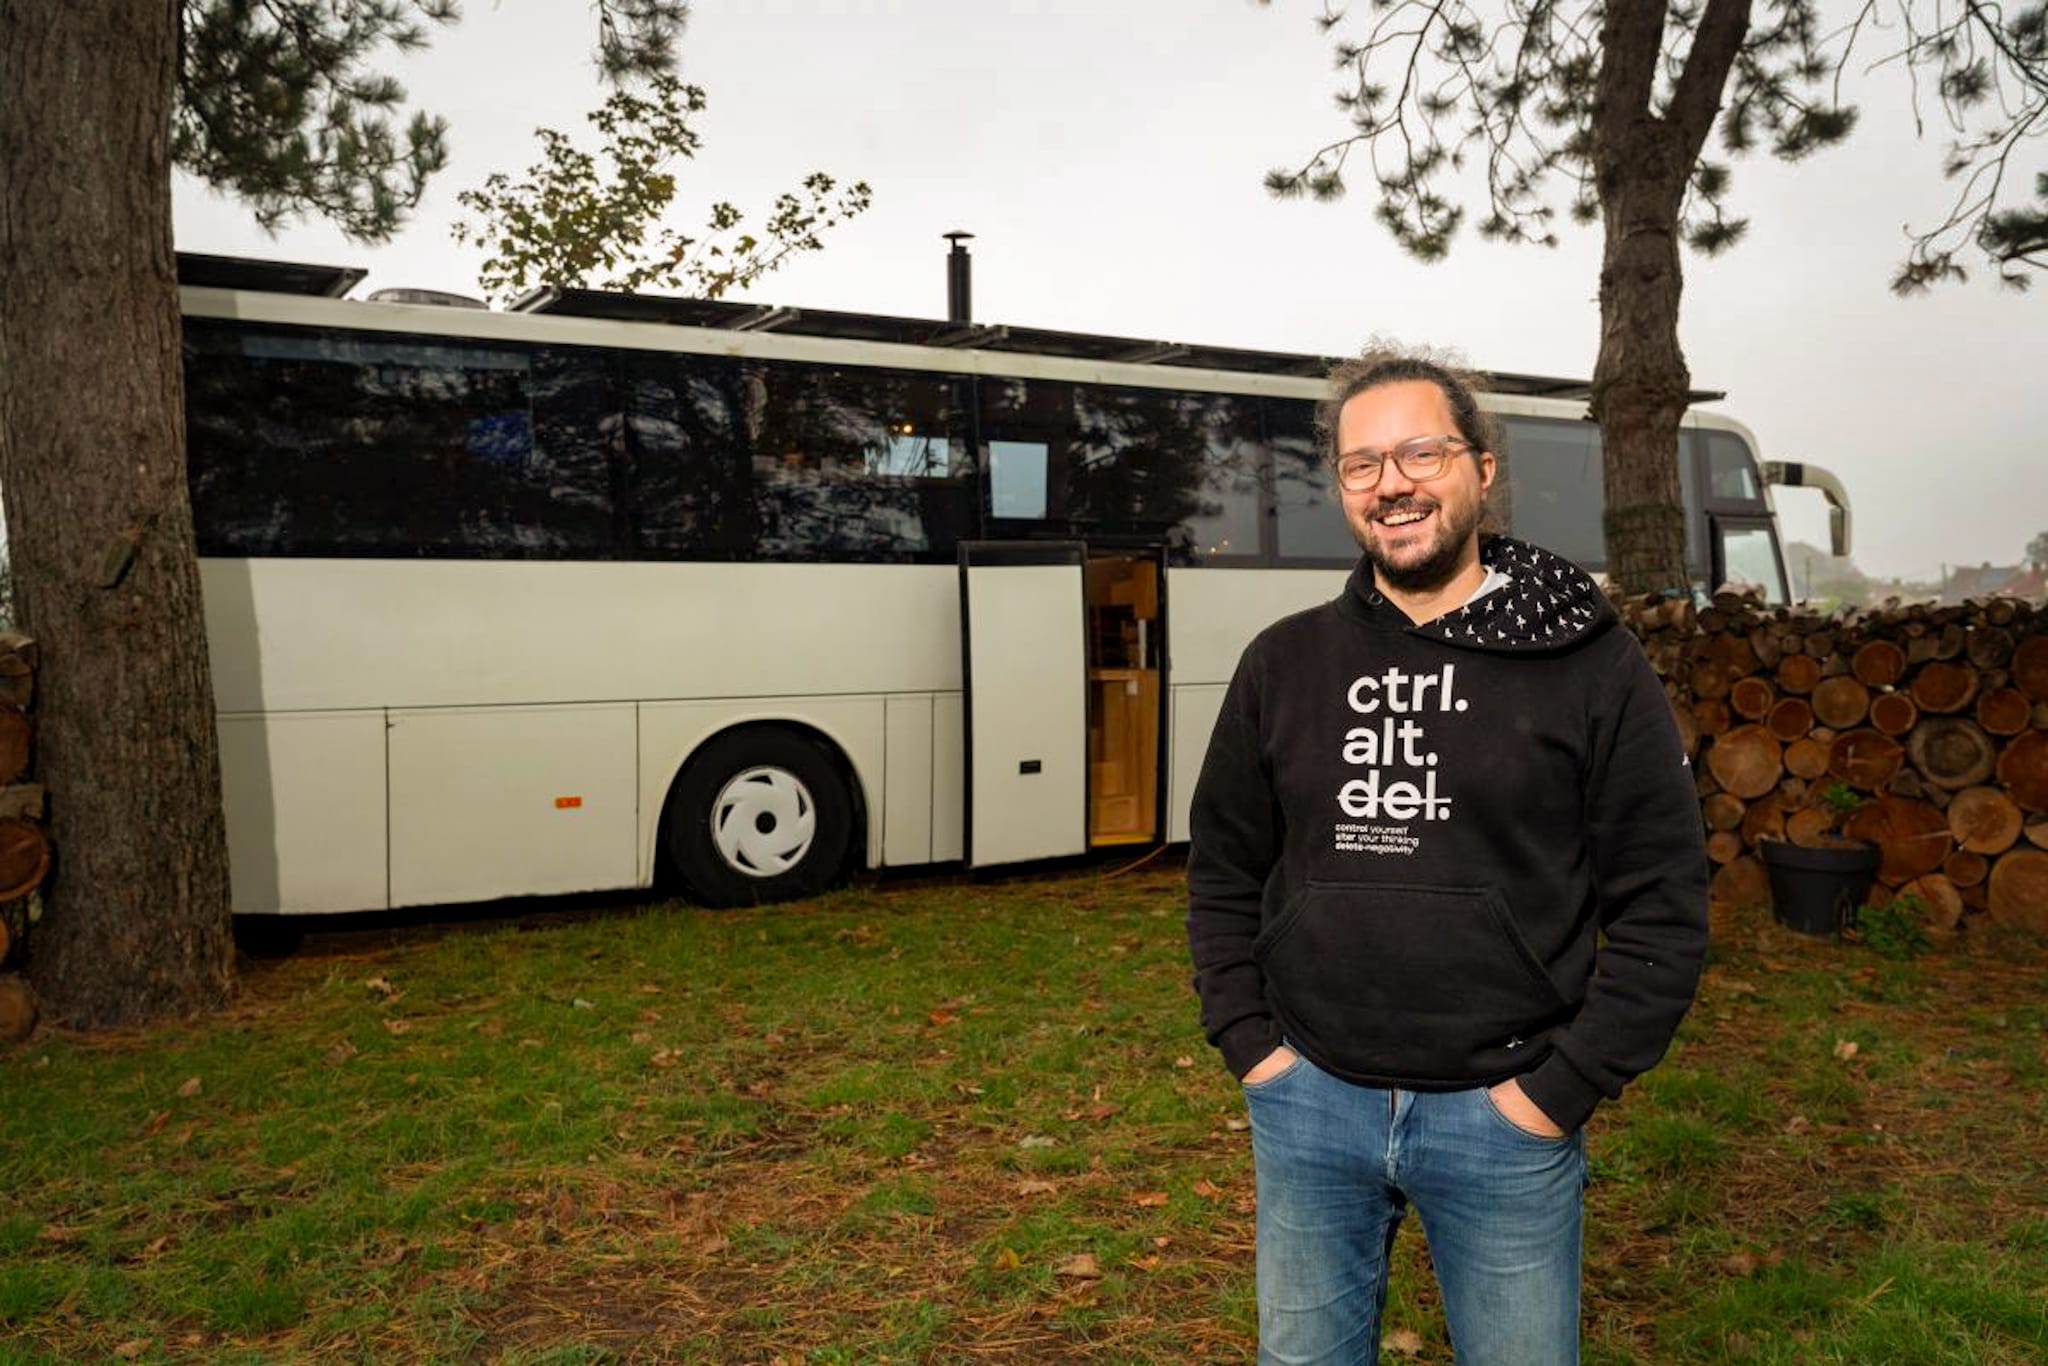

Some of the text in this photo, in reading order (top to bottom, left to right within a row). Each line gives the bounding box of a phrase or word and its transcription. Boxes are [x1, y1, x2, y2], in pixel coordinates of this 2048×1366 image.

[1347, 664, 1468, 713] ctrl.
[1342, 717, 1438, 766] alt.
[1337, 769, 1452, 820] del.
[1335, 824, 1408, 834] control yourself
[1358, 834, 1379, 843] your
[1381, 835, 1419, 847] thinking
